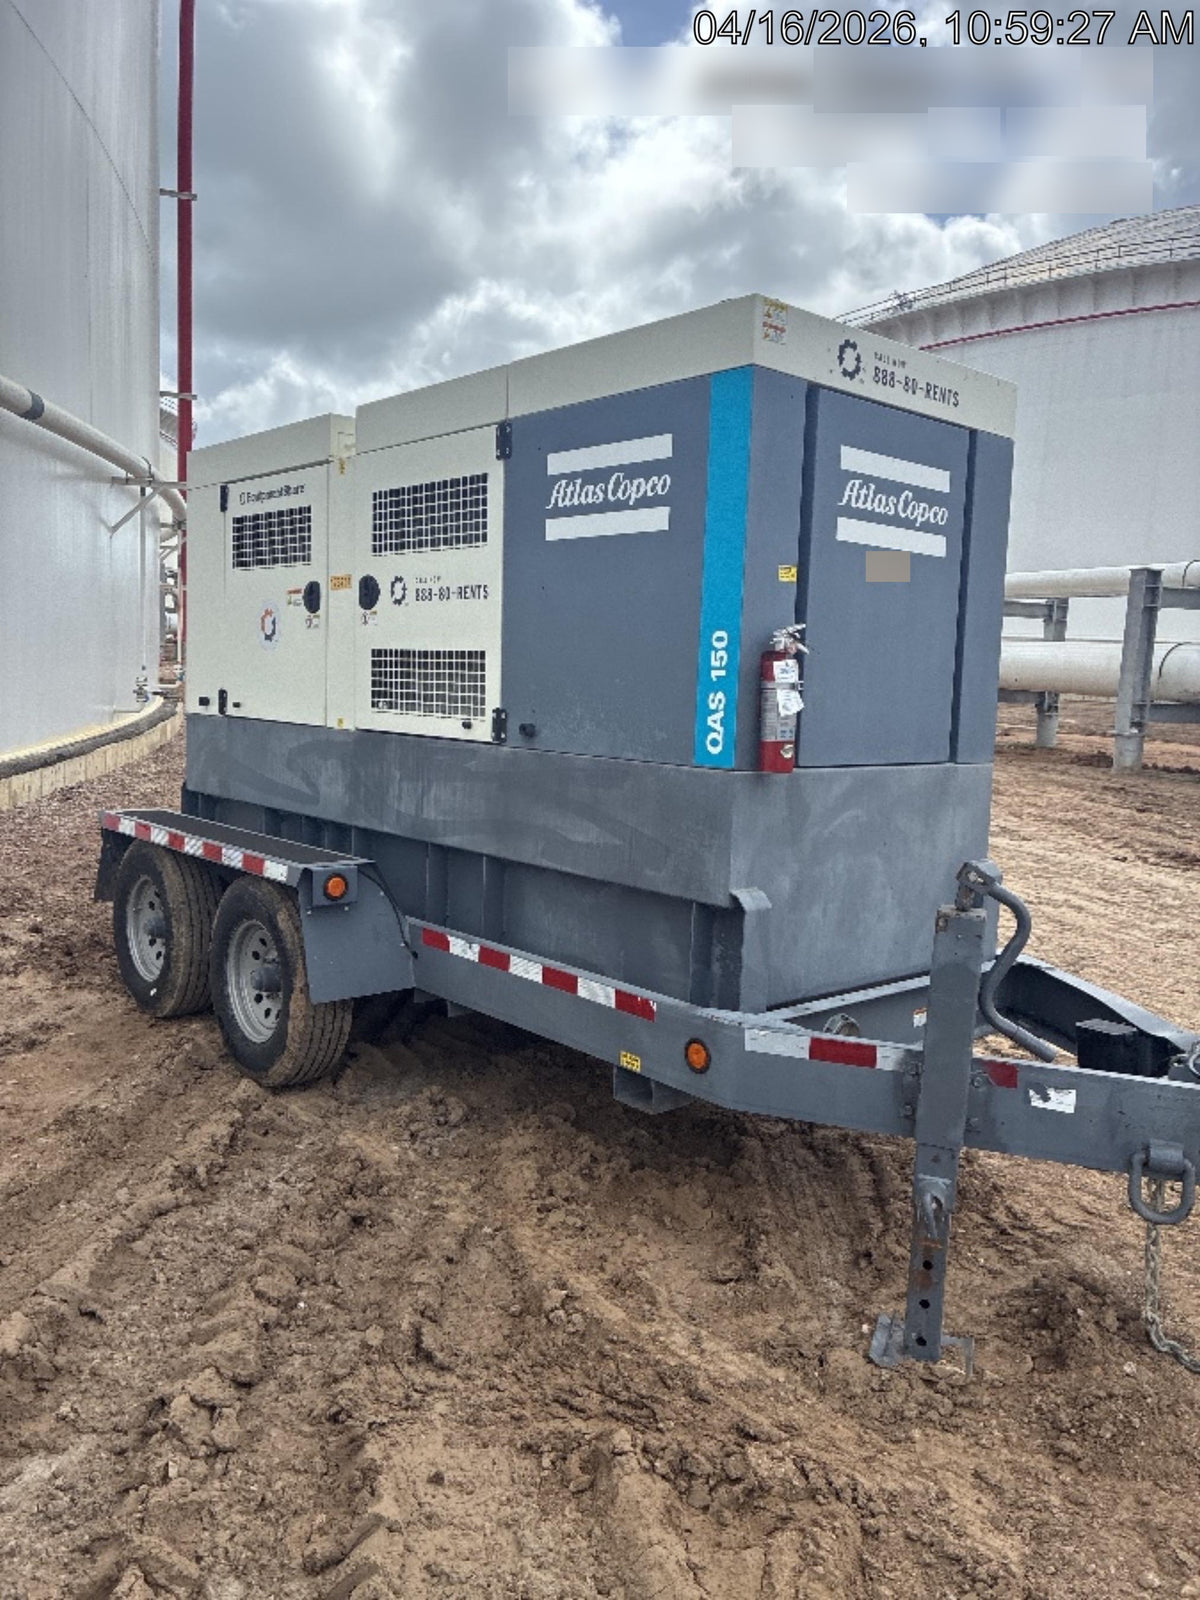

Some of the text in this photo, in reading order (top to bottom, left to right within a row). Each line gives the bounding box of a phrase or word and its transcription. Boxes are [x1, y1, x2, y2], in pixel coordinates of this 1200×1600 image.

[873, 365, 960, 408] 888-80-RENTS
[706, 629, 729, 755] QAS 150
